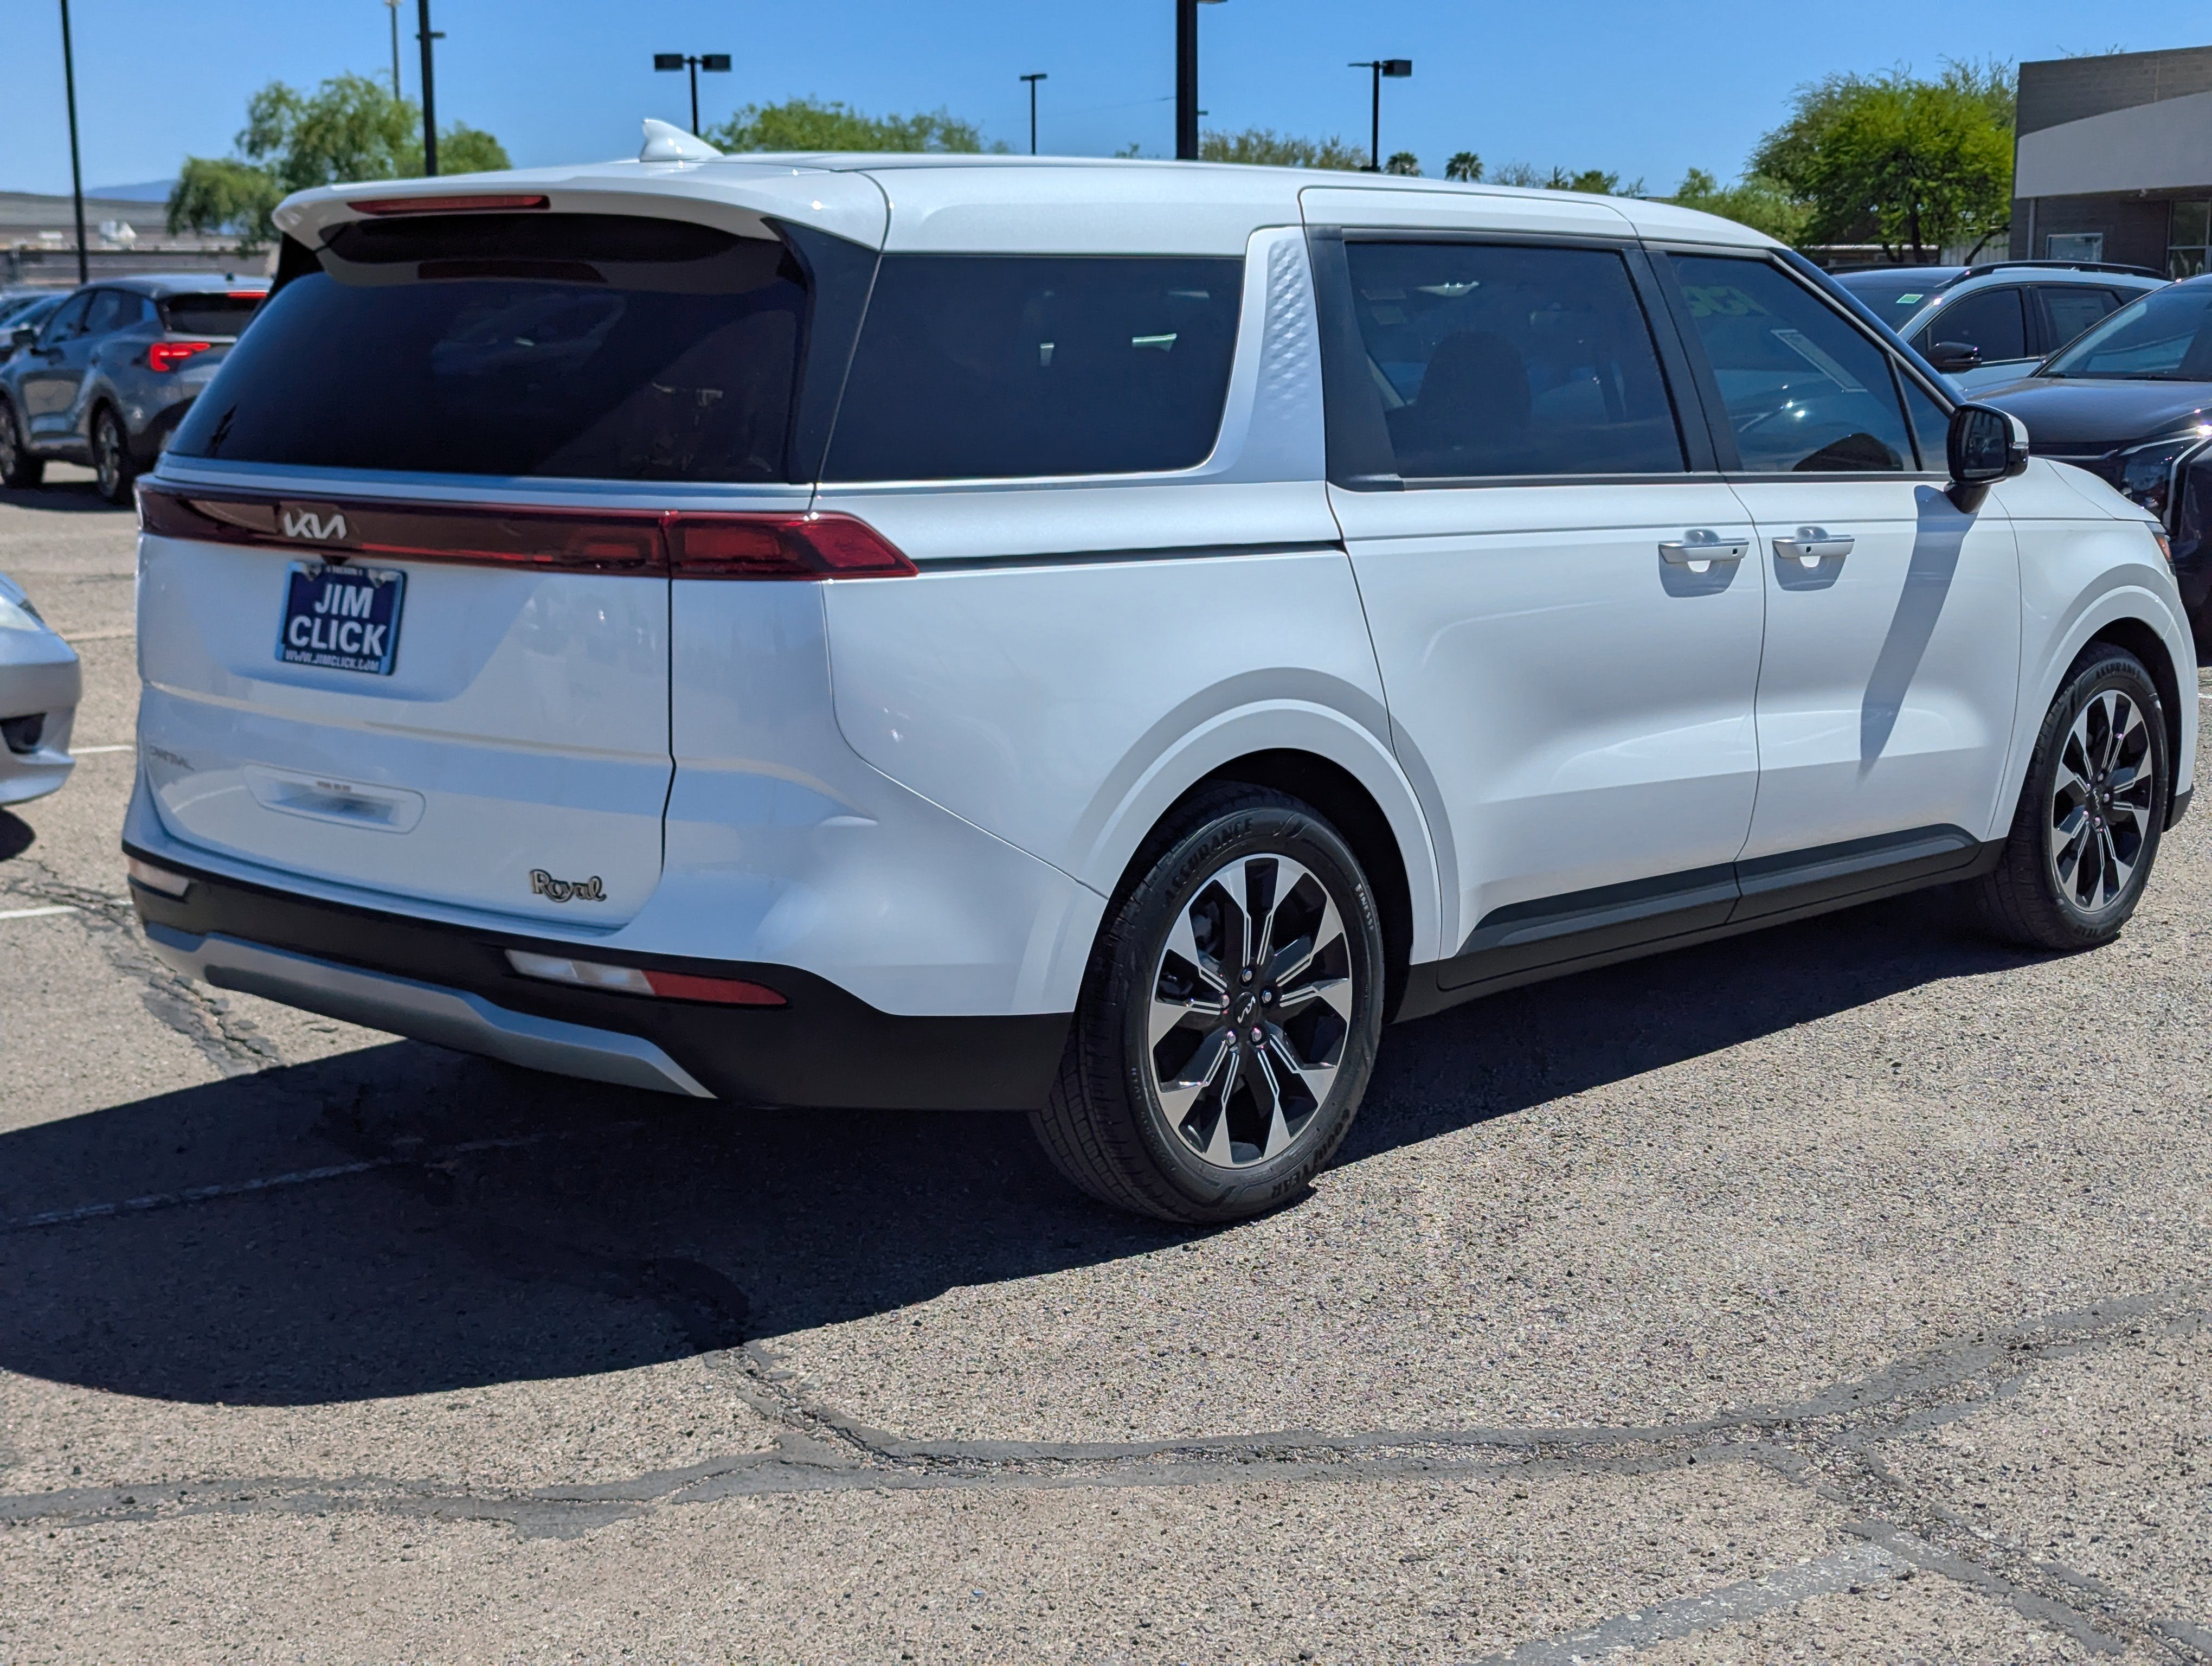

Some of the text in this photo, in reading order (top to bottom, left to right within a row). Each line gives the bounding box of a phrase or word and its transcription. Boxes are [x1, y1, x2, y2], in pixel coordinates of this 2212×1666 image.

[283, 511, 348, 540] KIA
[313, 582, 374, 619] JIM
[288, 614, 387, 657] CLICK
[1165, 818, 1254, 901] ASSURANCE
[529, 868, 607, 903] Royal
